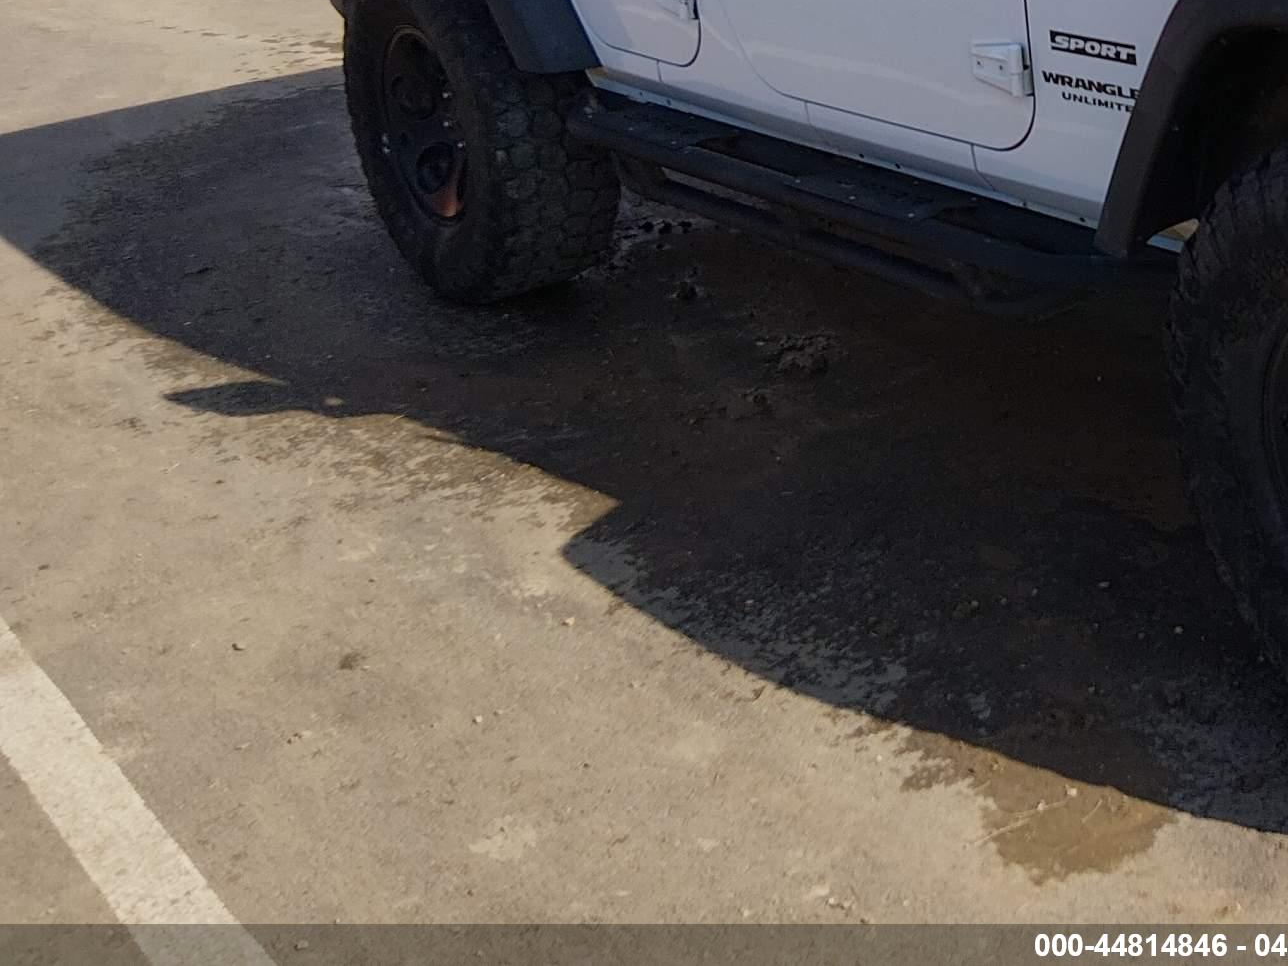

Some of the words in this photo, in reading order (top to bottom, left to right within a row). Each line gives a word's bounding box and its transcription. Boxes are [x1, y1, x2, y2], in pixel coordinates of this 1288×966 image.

[1053, 34, 1135, 61] SPORT
[1042, 71, 1141, 100] WRANGLE
[1061, 91, 1133, 112] UNLIMITE
